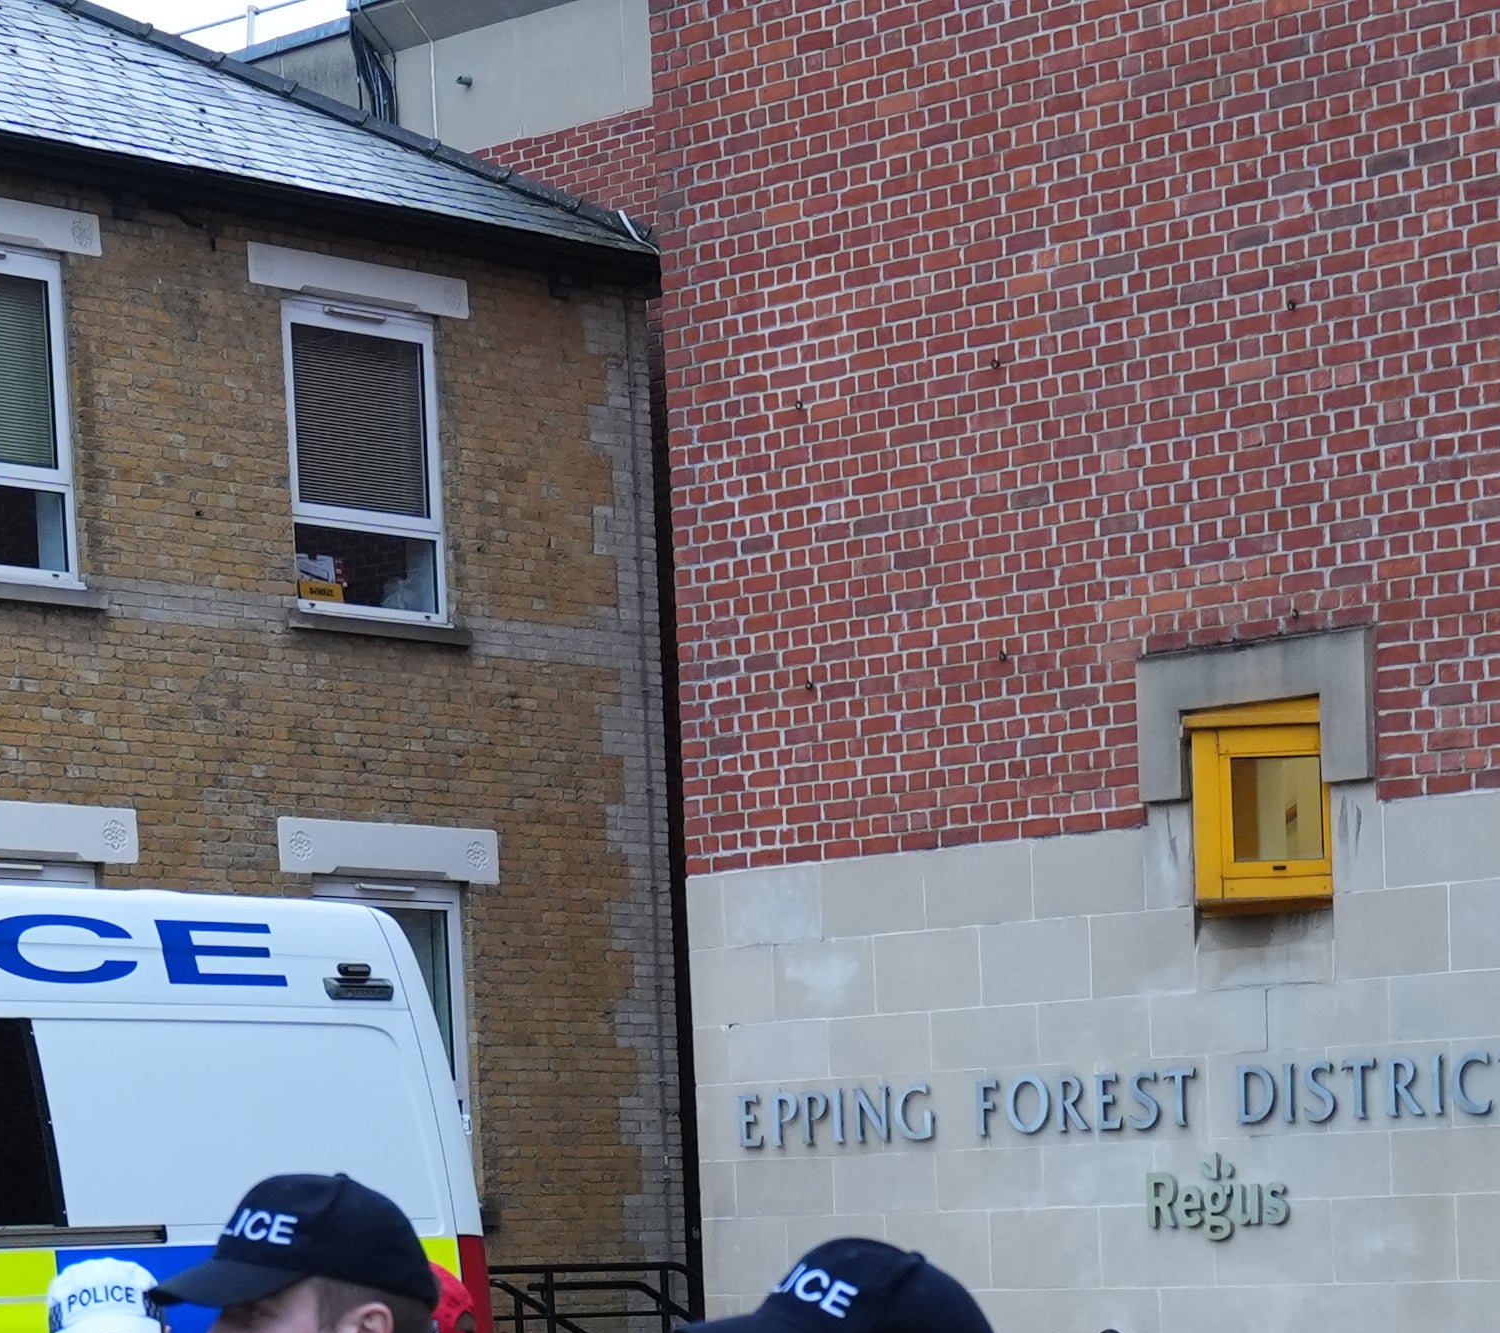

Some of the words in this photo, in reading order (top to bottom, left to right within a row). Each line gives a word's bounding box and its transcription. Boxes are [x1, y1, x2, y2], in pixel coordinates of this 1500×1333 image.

[738, 1083, 936, 1149] EPPING
[976, 1067, 1198, 1137] FOREST
[1146, 1166, 1291, 1241] Regus
[67, 1284, 137, 1313] POLICE
